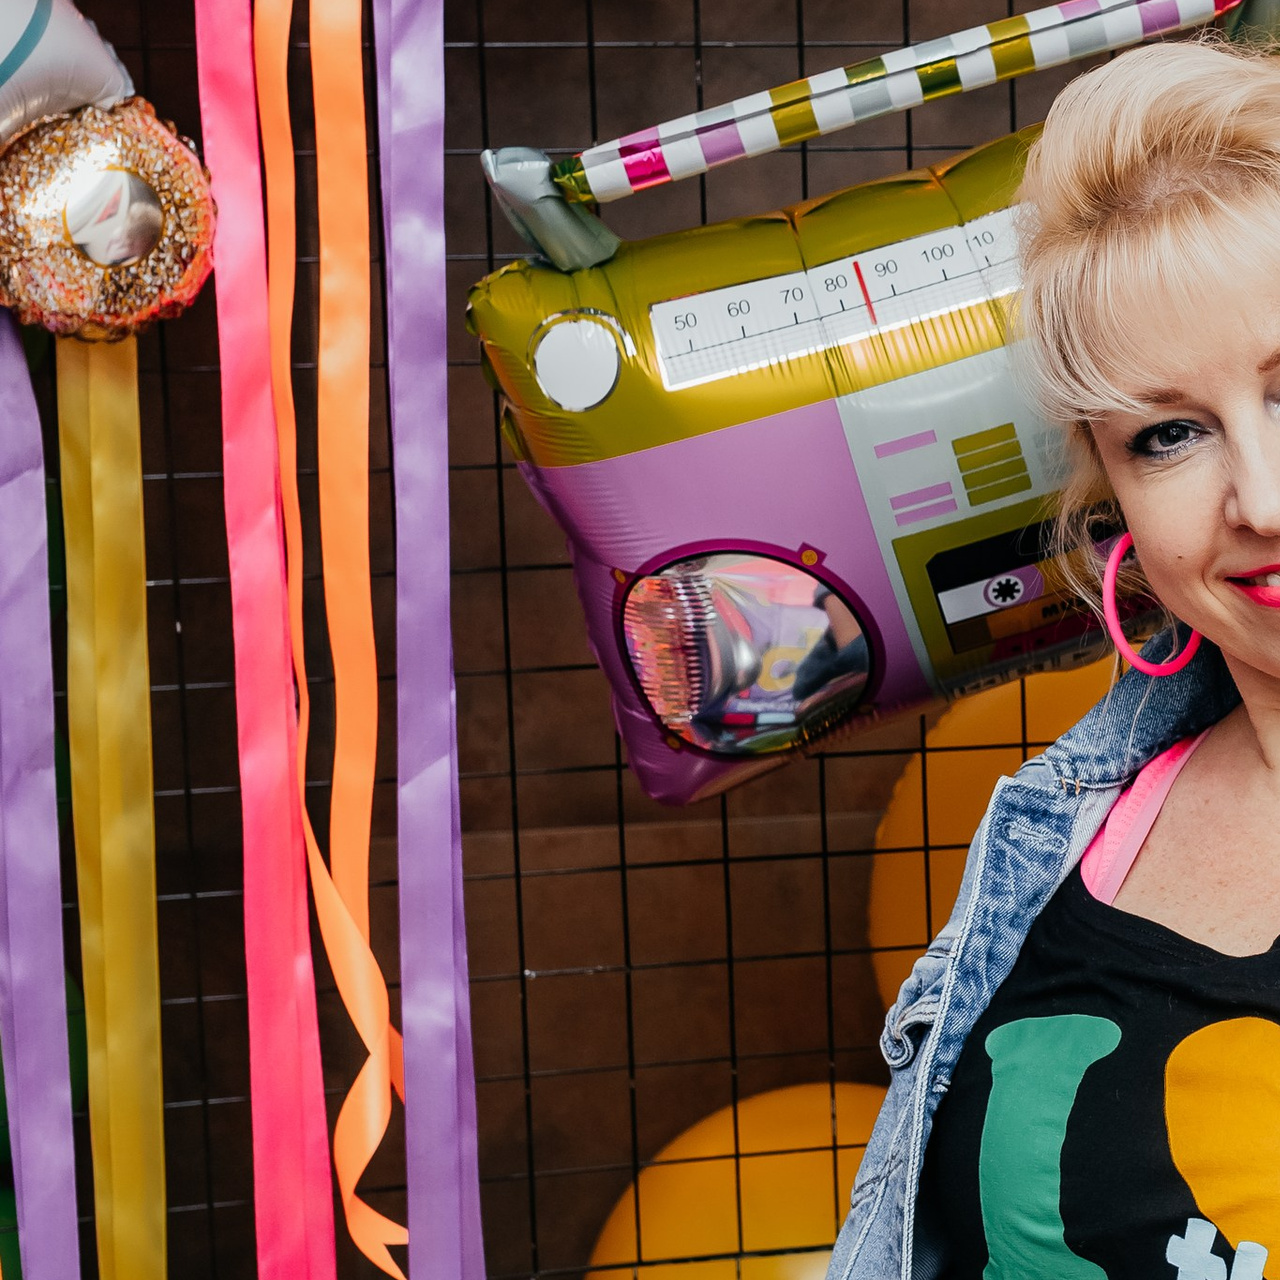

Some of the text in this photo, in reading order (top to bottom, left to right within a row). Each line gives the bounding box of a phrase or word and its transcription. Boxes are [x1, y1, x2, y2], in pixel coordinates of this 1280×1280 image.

[674, 312, 698, 331] 50
[727, 299, 751, 318] 60
[779, 287, 804, 305] 70
[824, 274, 848, 293] 80
[874, 259, 898, 278] 90
[920, 243, 955, 263] 100
